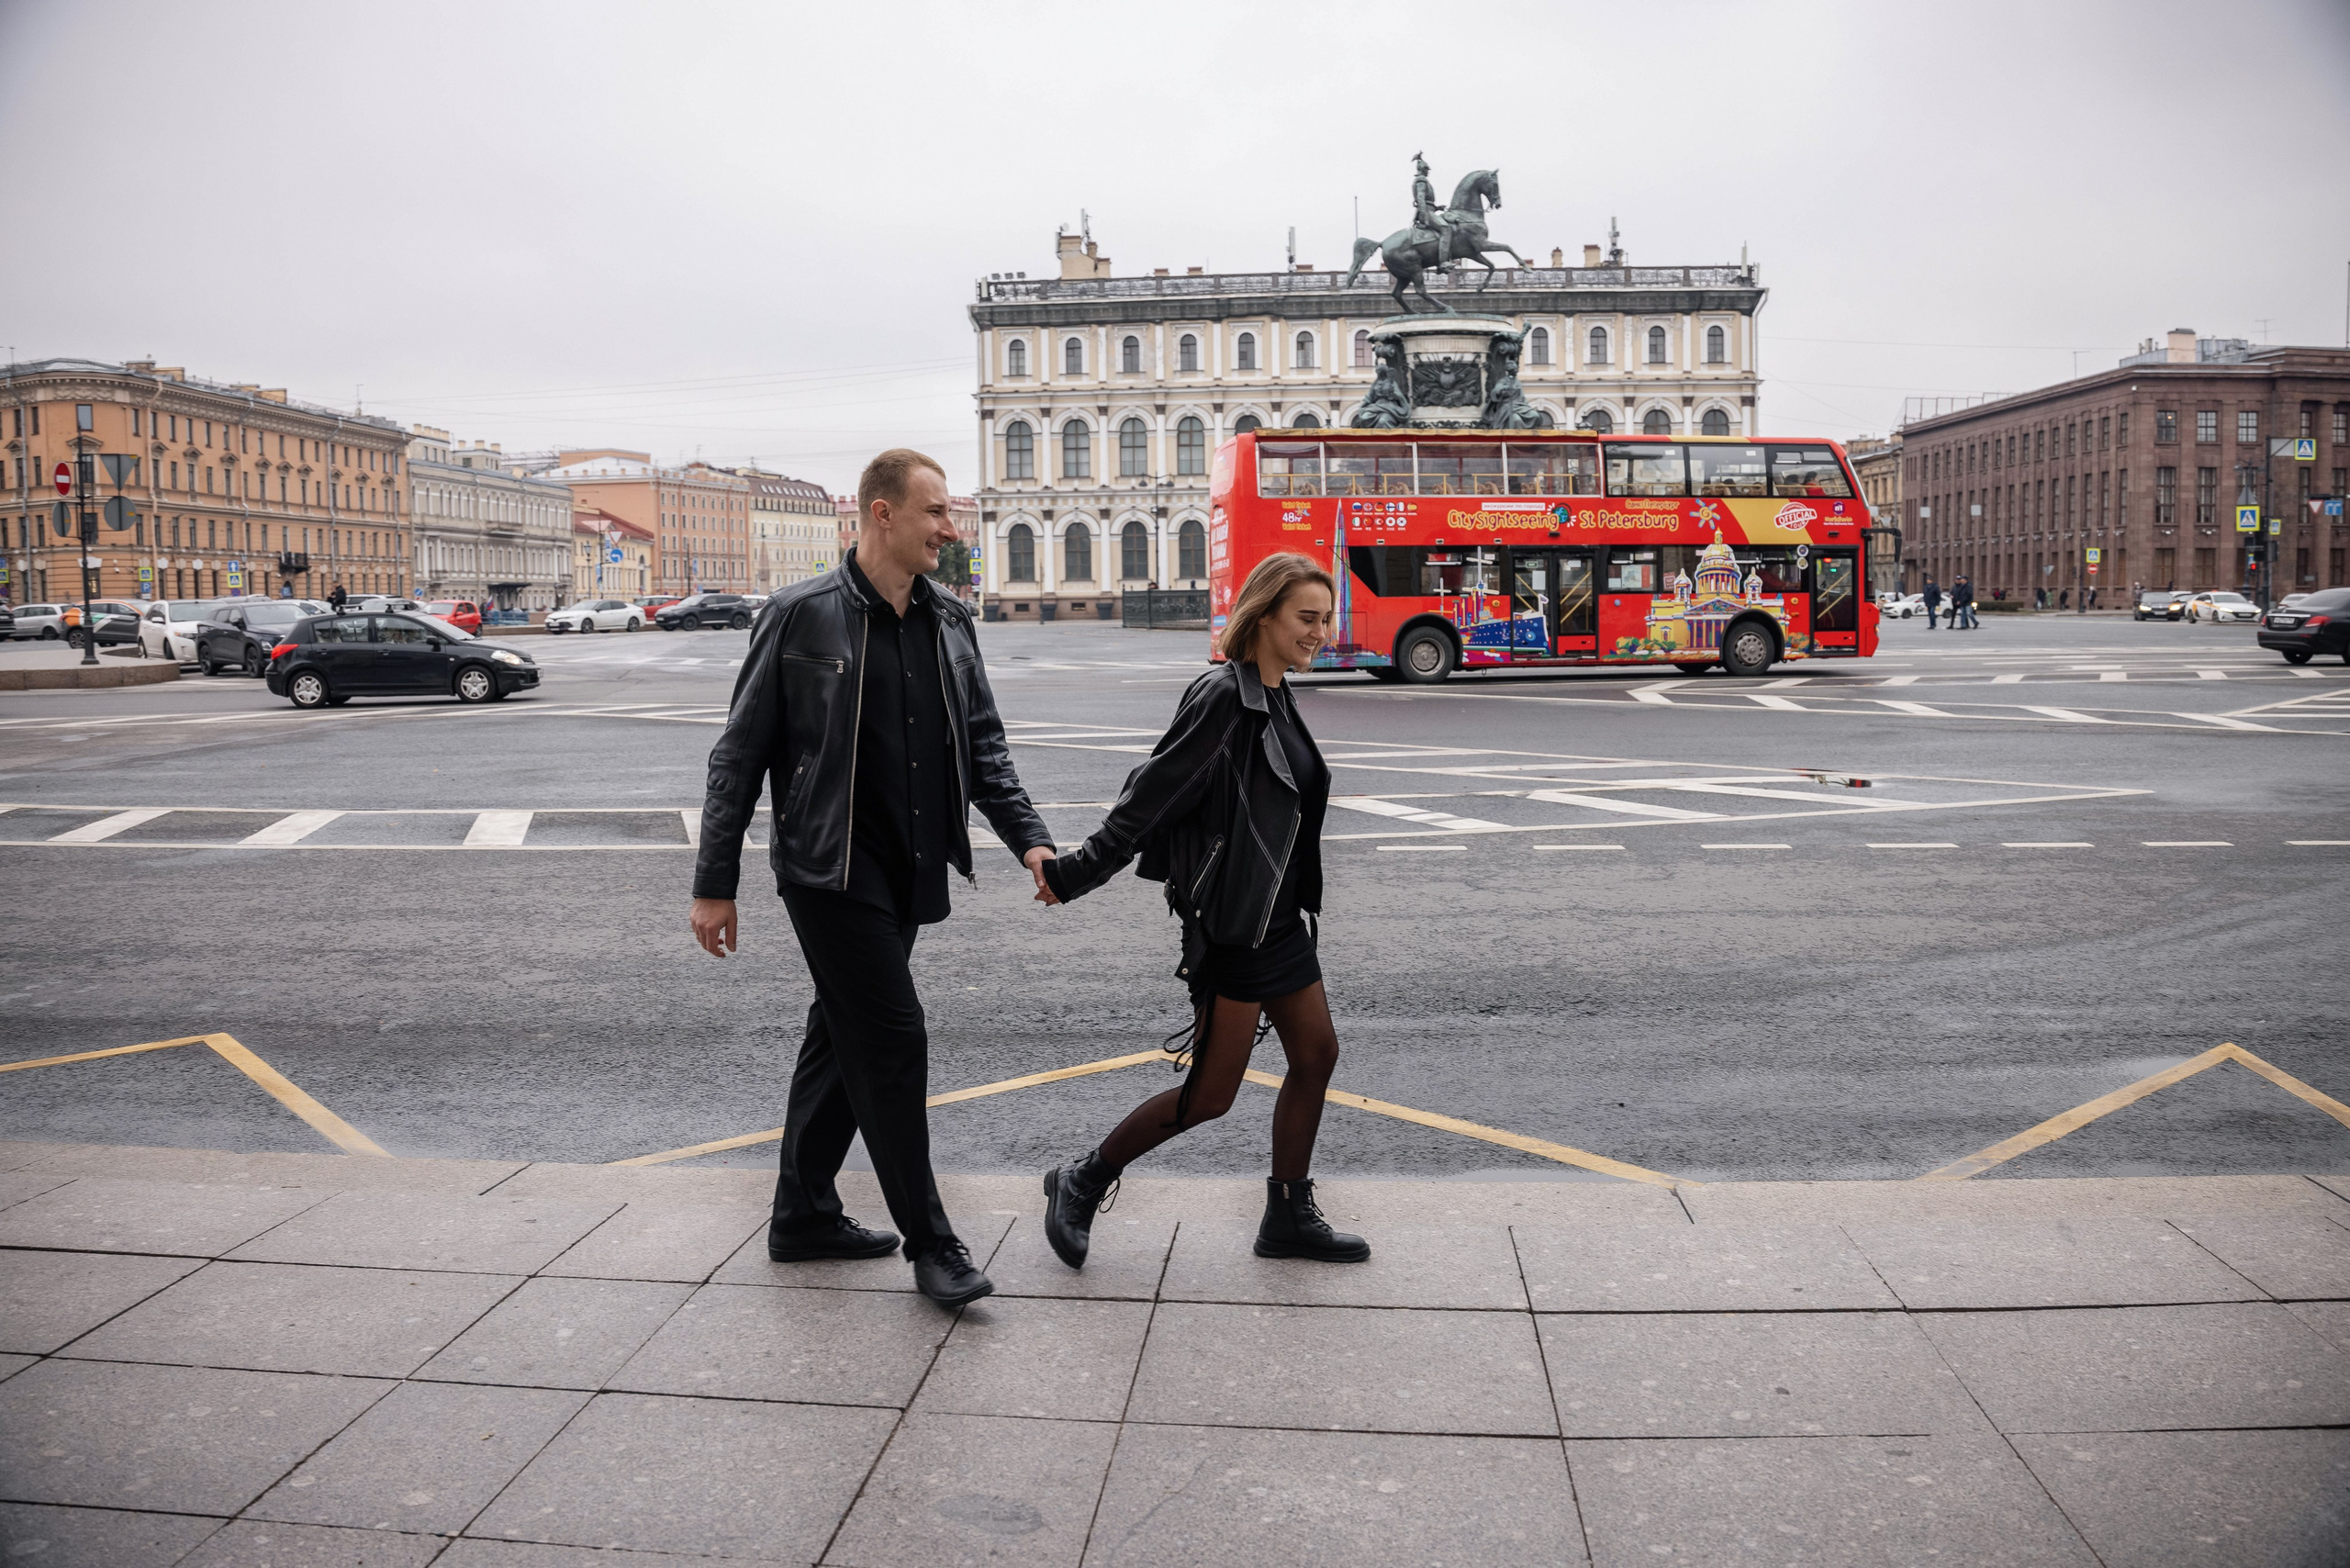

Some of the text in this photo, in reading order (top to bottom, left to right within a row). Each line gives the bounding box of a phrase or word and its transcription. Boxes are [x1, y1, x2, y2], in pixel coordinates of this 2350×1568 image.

[1282, 511, 1303, 522] 48hr
[1448, 510, 1560, 531] CitySightseeing
[1579, 510, 1679, 532] St Petersburg
[1778, 510, 1814, 524] OFFICIAL
[1790, 521, 1807, 529] TOUR
